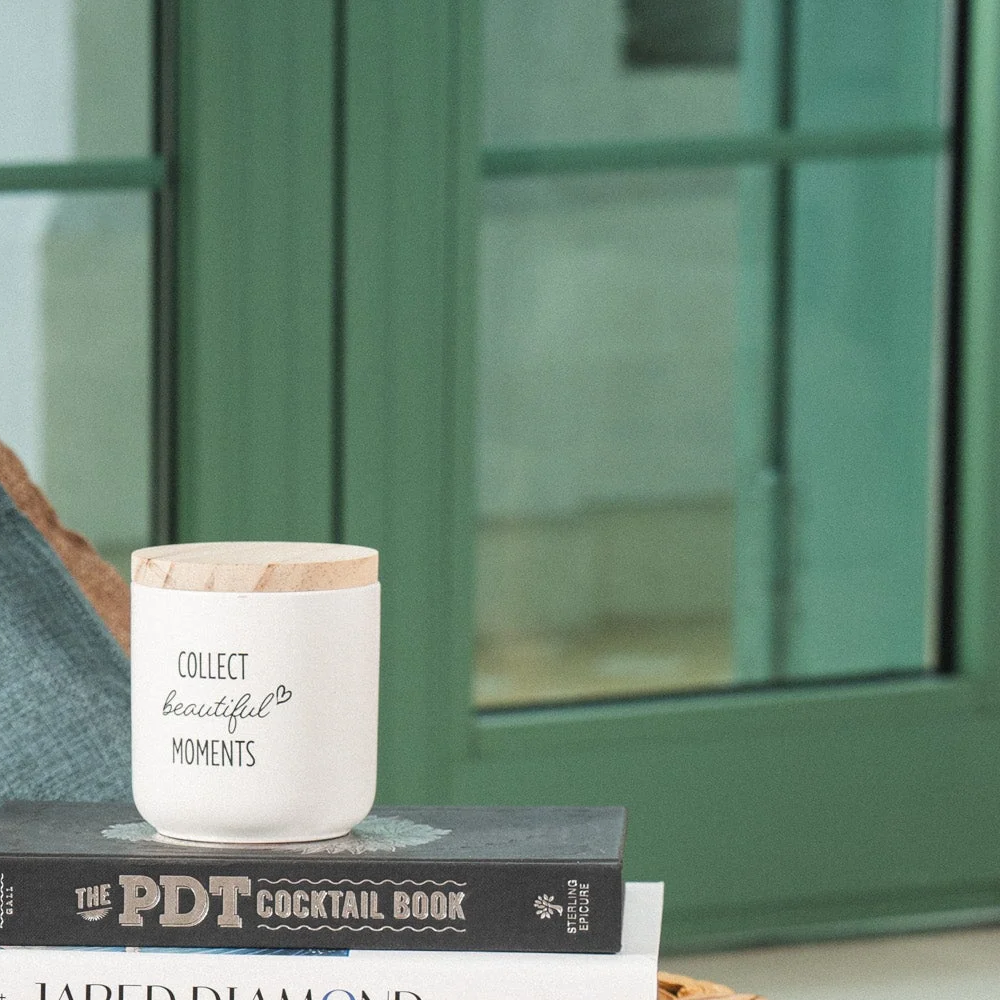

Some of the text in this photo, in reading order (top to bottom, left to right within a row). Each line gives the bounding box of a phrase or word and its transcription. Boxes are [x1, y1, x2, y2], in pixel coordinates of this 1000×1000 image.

[178, 651, 248, 680] COLLECT
[162, 689, 275, 734] beautiful
[172, 737, 256, 767] MOMENTS
[5, 886, 14, 915] GALL
[75, 874, 466, 928] THE PDT COCKTAIL BOOK
[566, 879, 578, 934] STERLING
[578, 883, 590, 931] EPICURE
